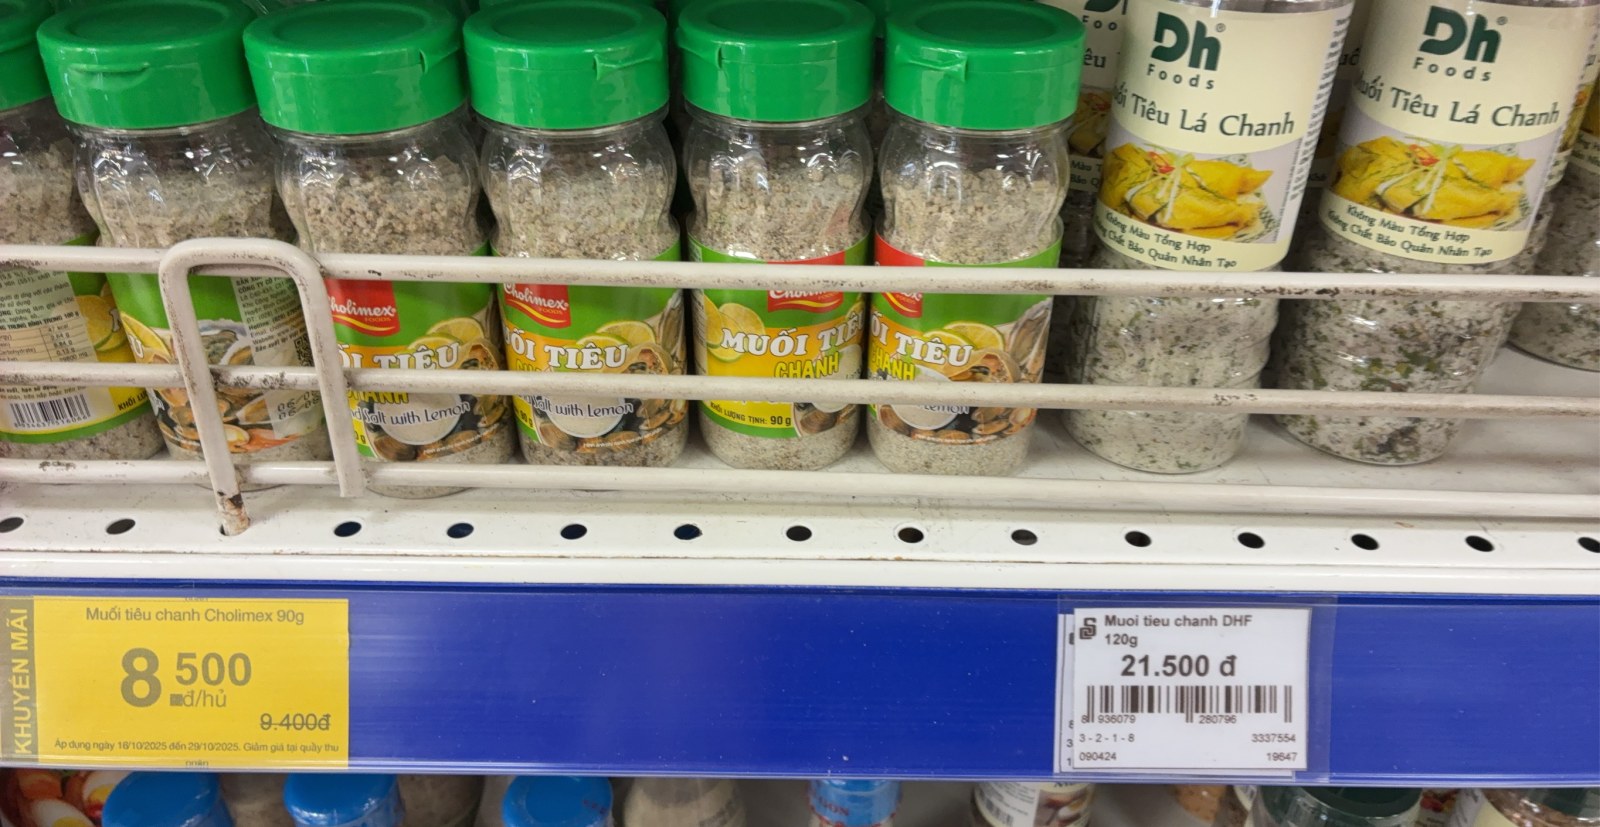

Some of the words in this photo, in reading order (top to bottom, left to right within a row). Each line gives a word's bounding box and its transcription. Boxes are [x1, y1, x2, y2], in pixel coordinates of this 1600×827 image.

[1151, 11, 1221, 72] Dh
[1418, 5, 1501, 64] Dh
[1147, 63, 1215, 90] Foods
[1413, 56, 1492, 82] Foods
[1131, 92, 1170, 126] Tiêu
[1180, 109, 1207, 133] Lá
[1219, 112, 1295, 137] Chanh
[1391, 85, 1439, 119] Tiêu
[1450, 101, 1479, 125] Lá
[1492, 102, 1560, 127] Chanh
[1129, 224, 1151, 240] Màu
[1154, 233, 1182, 251] Tổng
[1186, 240, 1212, 254] Hợp
[1379, 217, 1405, 233] Màu
[1409, 224, 1441, 242] Tổng
[1444, 230, 1471, 244] Hợp
[328, 295, 396, 317] holimex
[720, 327, 809, 357] MUỐI
[895, 331, 974, 367] TIÊU
[543, 342, 629, 370] TIÊU
[390, 409, 421, 426] with
[424, 401, 473, 423] Lemon
[555, 404, 584, 417] with
[587, 403, 634, 418] Lemon
[770, 415, 783, 426] 90
[785, 417, 792, 427] g
[86, 605, 121, 621] Muối
[125, 607, 151, 621] tiêu
[155, 608, 200, 622] chanh
[204, 608, 273, 623] Cholimex
[277, 609, 305, 626] 90g
[1104, 614, 1139, 628] Muoi
[1143, 615, 1170, 628] tieu
[1174, 615, 1218, 628] chanh
[1222, 615, 1253, 628] DHF
[6, 608, 28, 650] MÃI
[1104, 633, 1138, 648] 120g
[120, 647, 162, 708] 8
[175, 652, 252, 687] 500
[1120, 654, 1211, 678] 21.500
[1219, 655, 1237, 677] đ
[260, 713, 331, 731] 9.400đ
[1097, 714, 1137, 724] 936079
[1198, 714, 1237, 725] 280796
[68, 739, 91, 752] dụng
[92, 741, 115, 752] ngày
[324, 743, 339, 752] thu
[1251, 733, 1296, 743] 3337554
[1079, 751, 1117, 761] 090424
